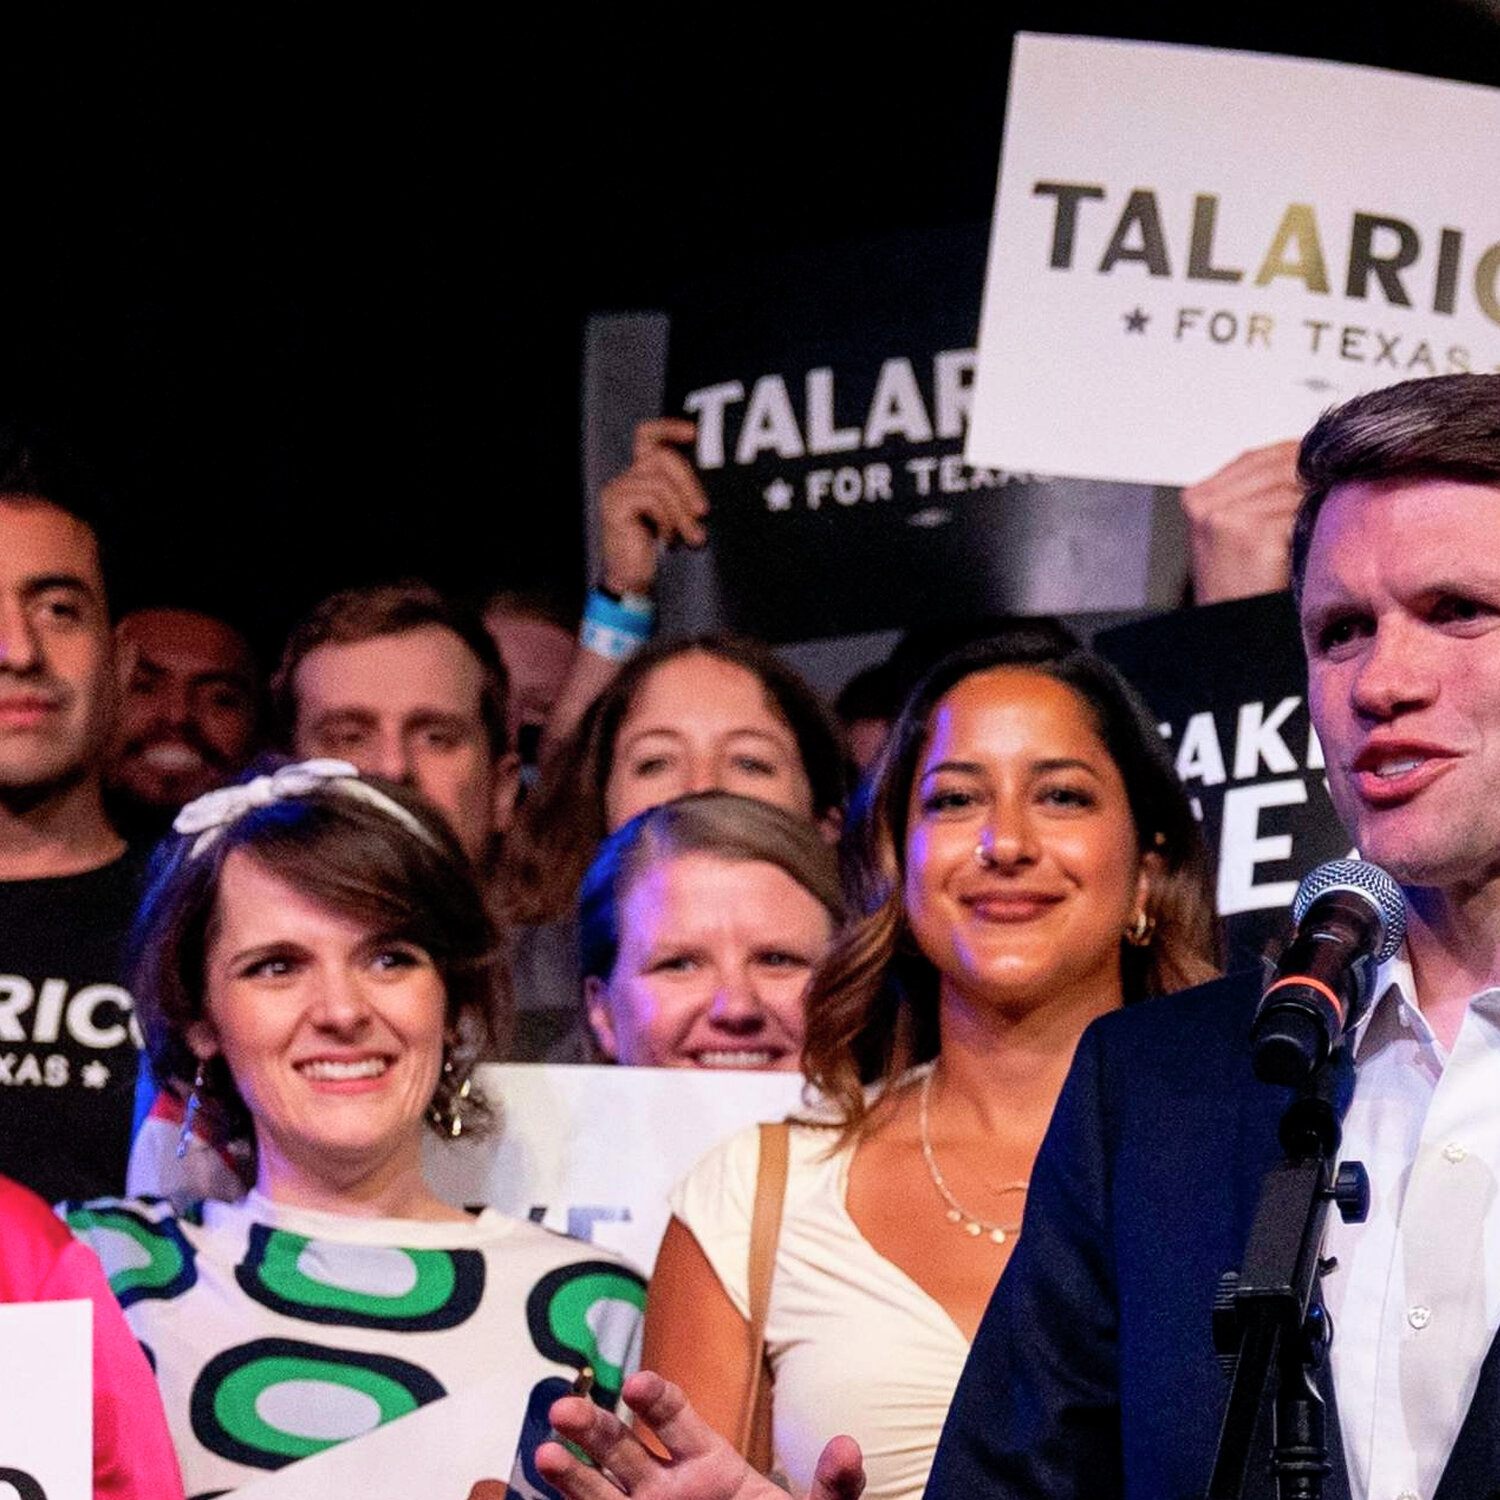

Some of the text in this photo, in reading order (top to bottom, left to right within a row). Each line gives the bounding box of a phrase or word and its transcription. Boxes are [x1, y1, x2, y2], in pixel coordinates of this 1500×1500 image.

[1173, 307, 1474, 374] FOR TEXAS
[804, 463, 893, 511] FOR
[0, 973, 146, 1050] RIC
